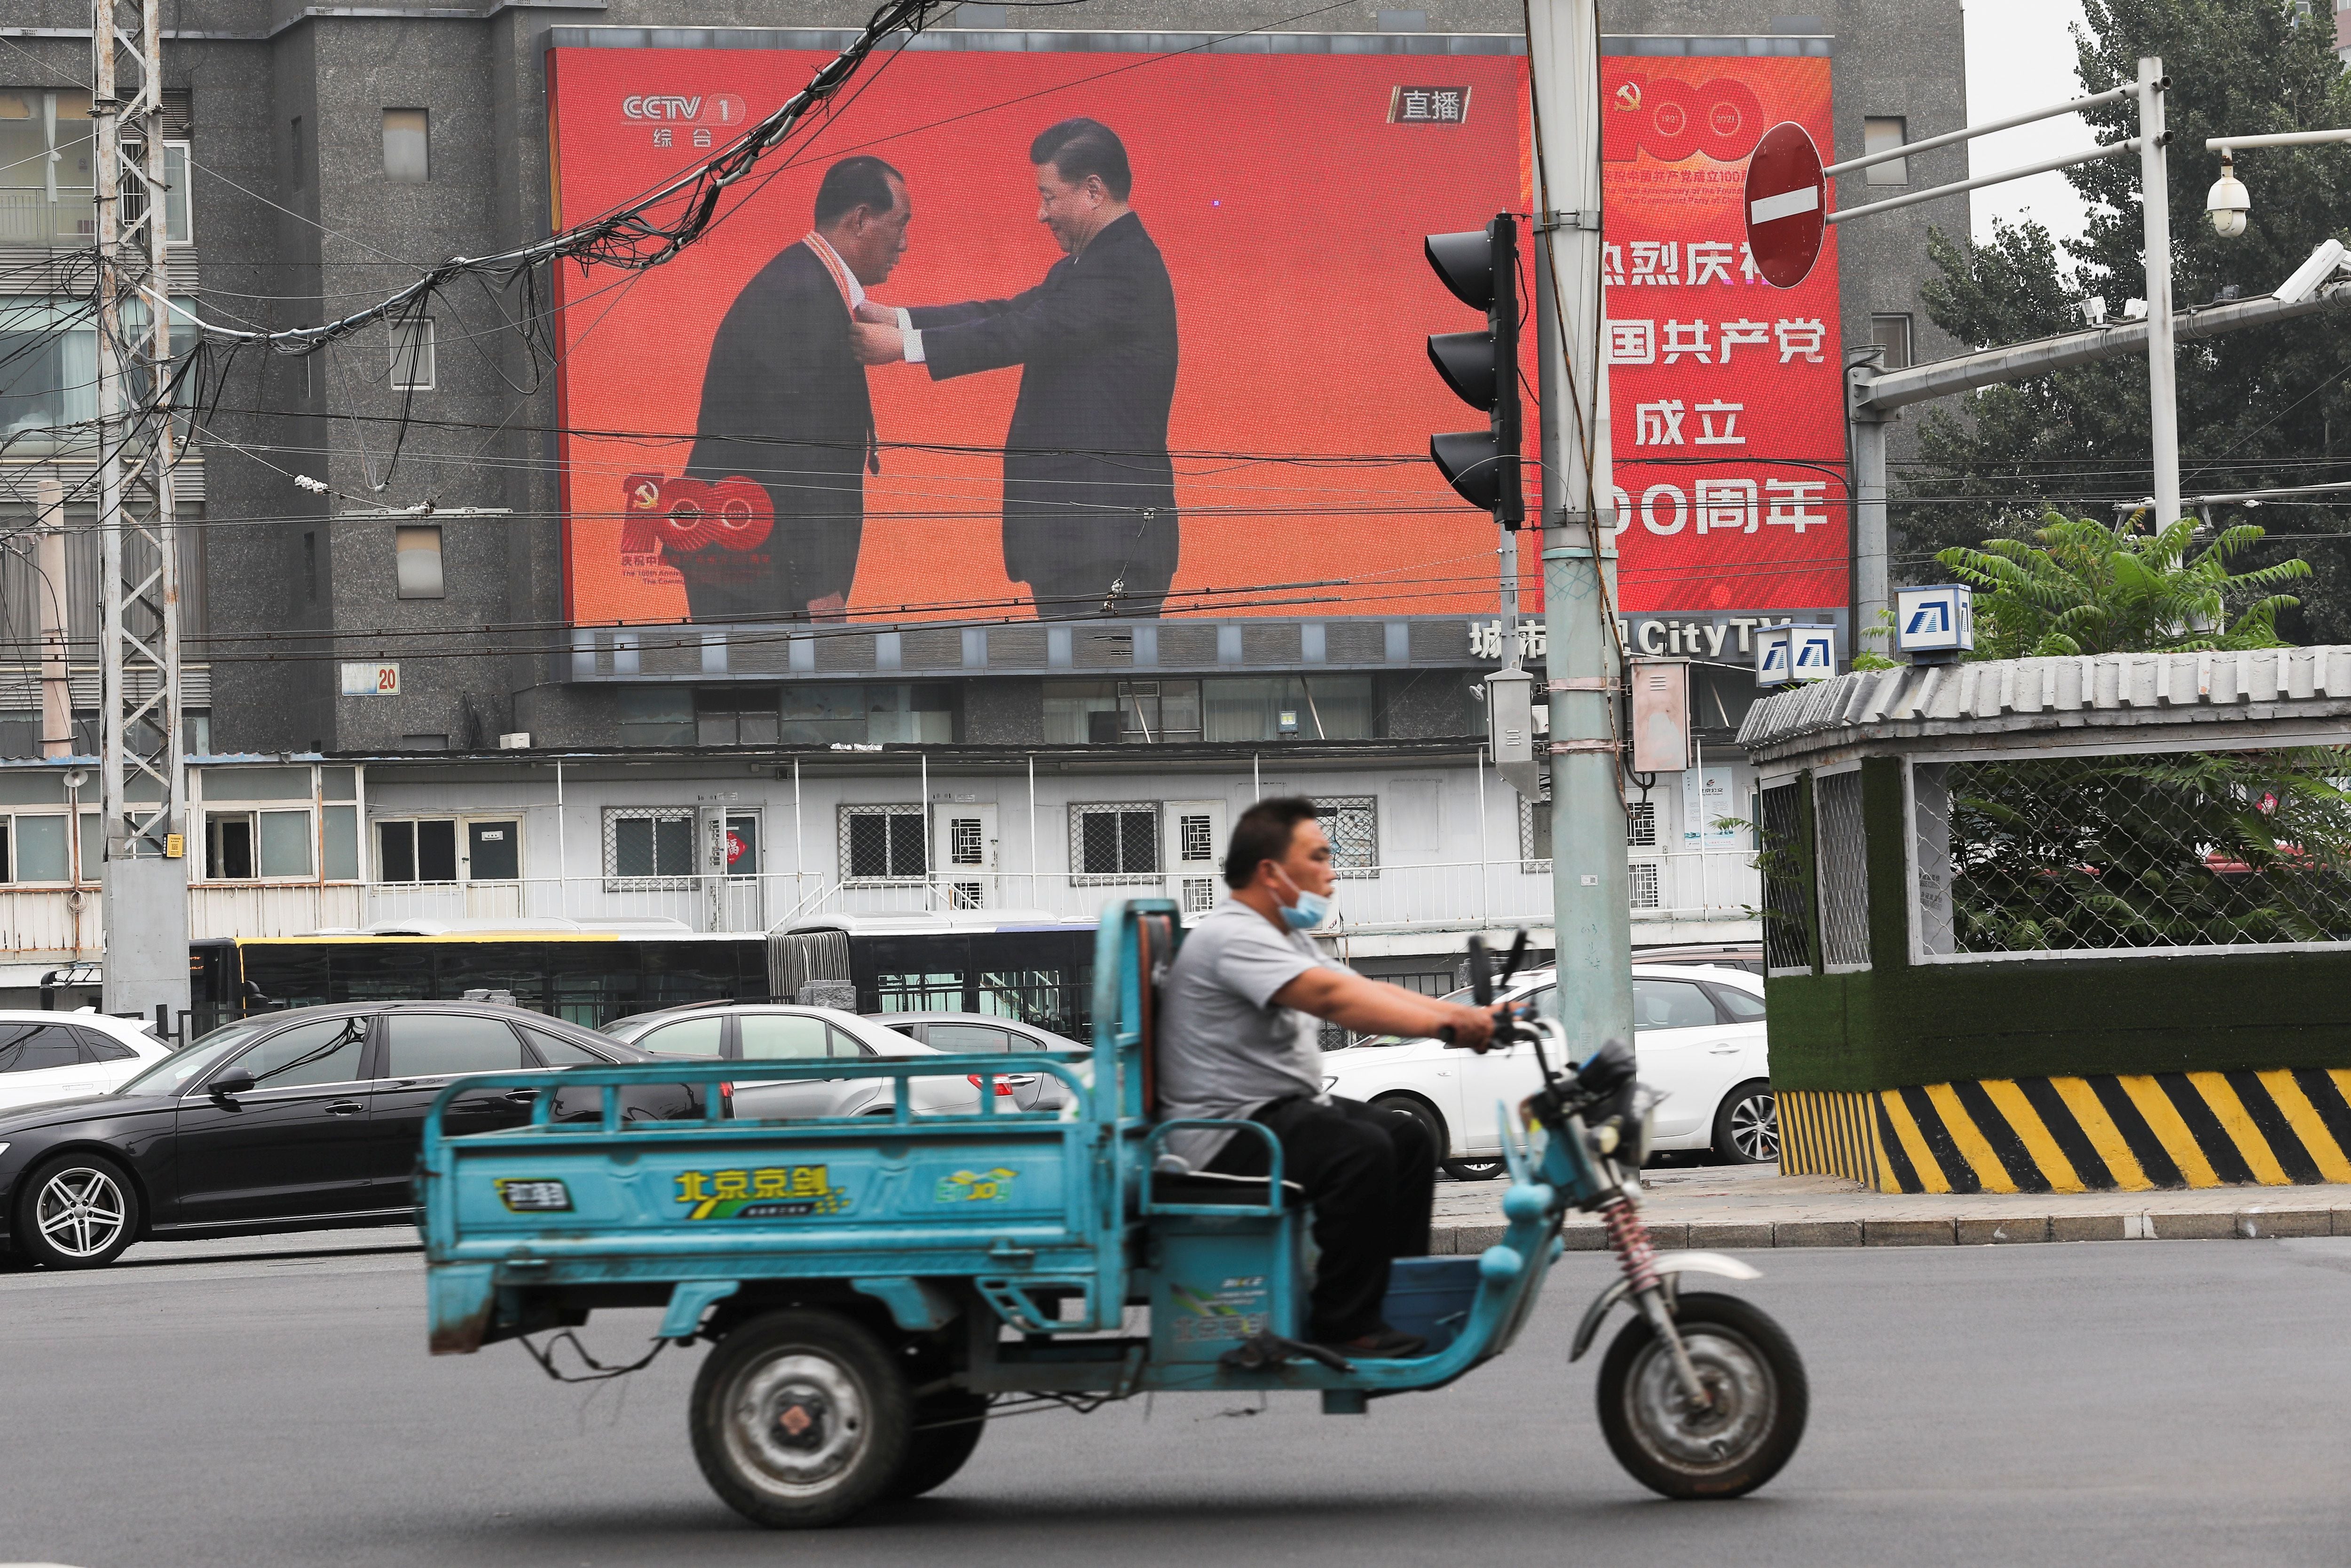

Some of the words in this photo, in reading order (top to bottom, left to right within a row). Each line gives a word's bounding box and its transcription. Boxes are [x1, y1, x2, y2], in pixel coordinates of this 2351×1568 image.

[622, 95, 702, 119] CCTV
[720, 100, 729, 120] 1
[1403, 90, 1460, 120] 直播
[654, 128, 711, 148] 综合
[1635, 399, 1746, 445] 成立
[1638, 621, 1727, 657] City
[379, 669, 395, 690] 20
